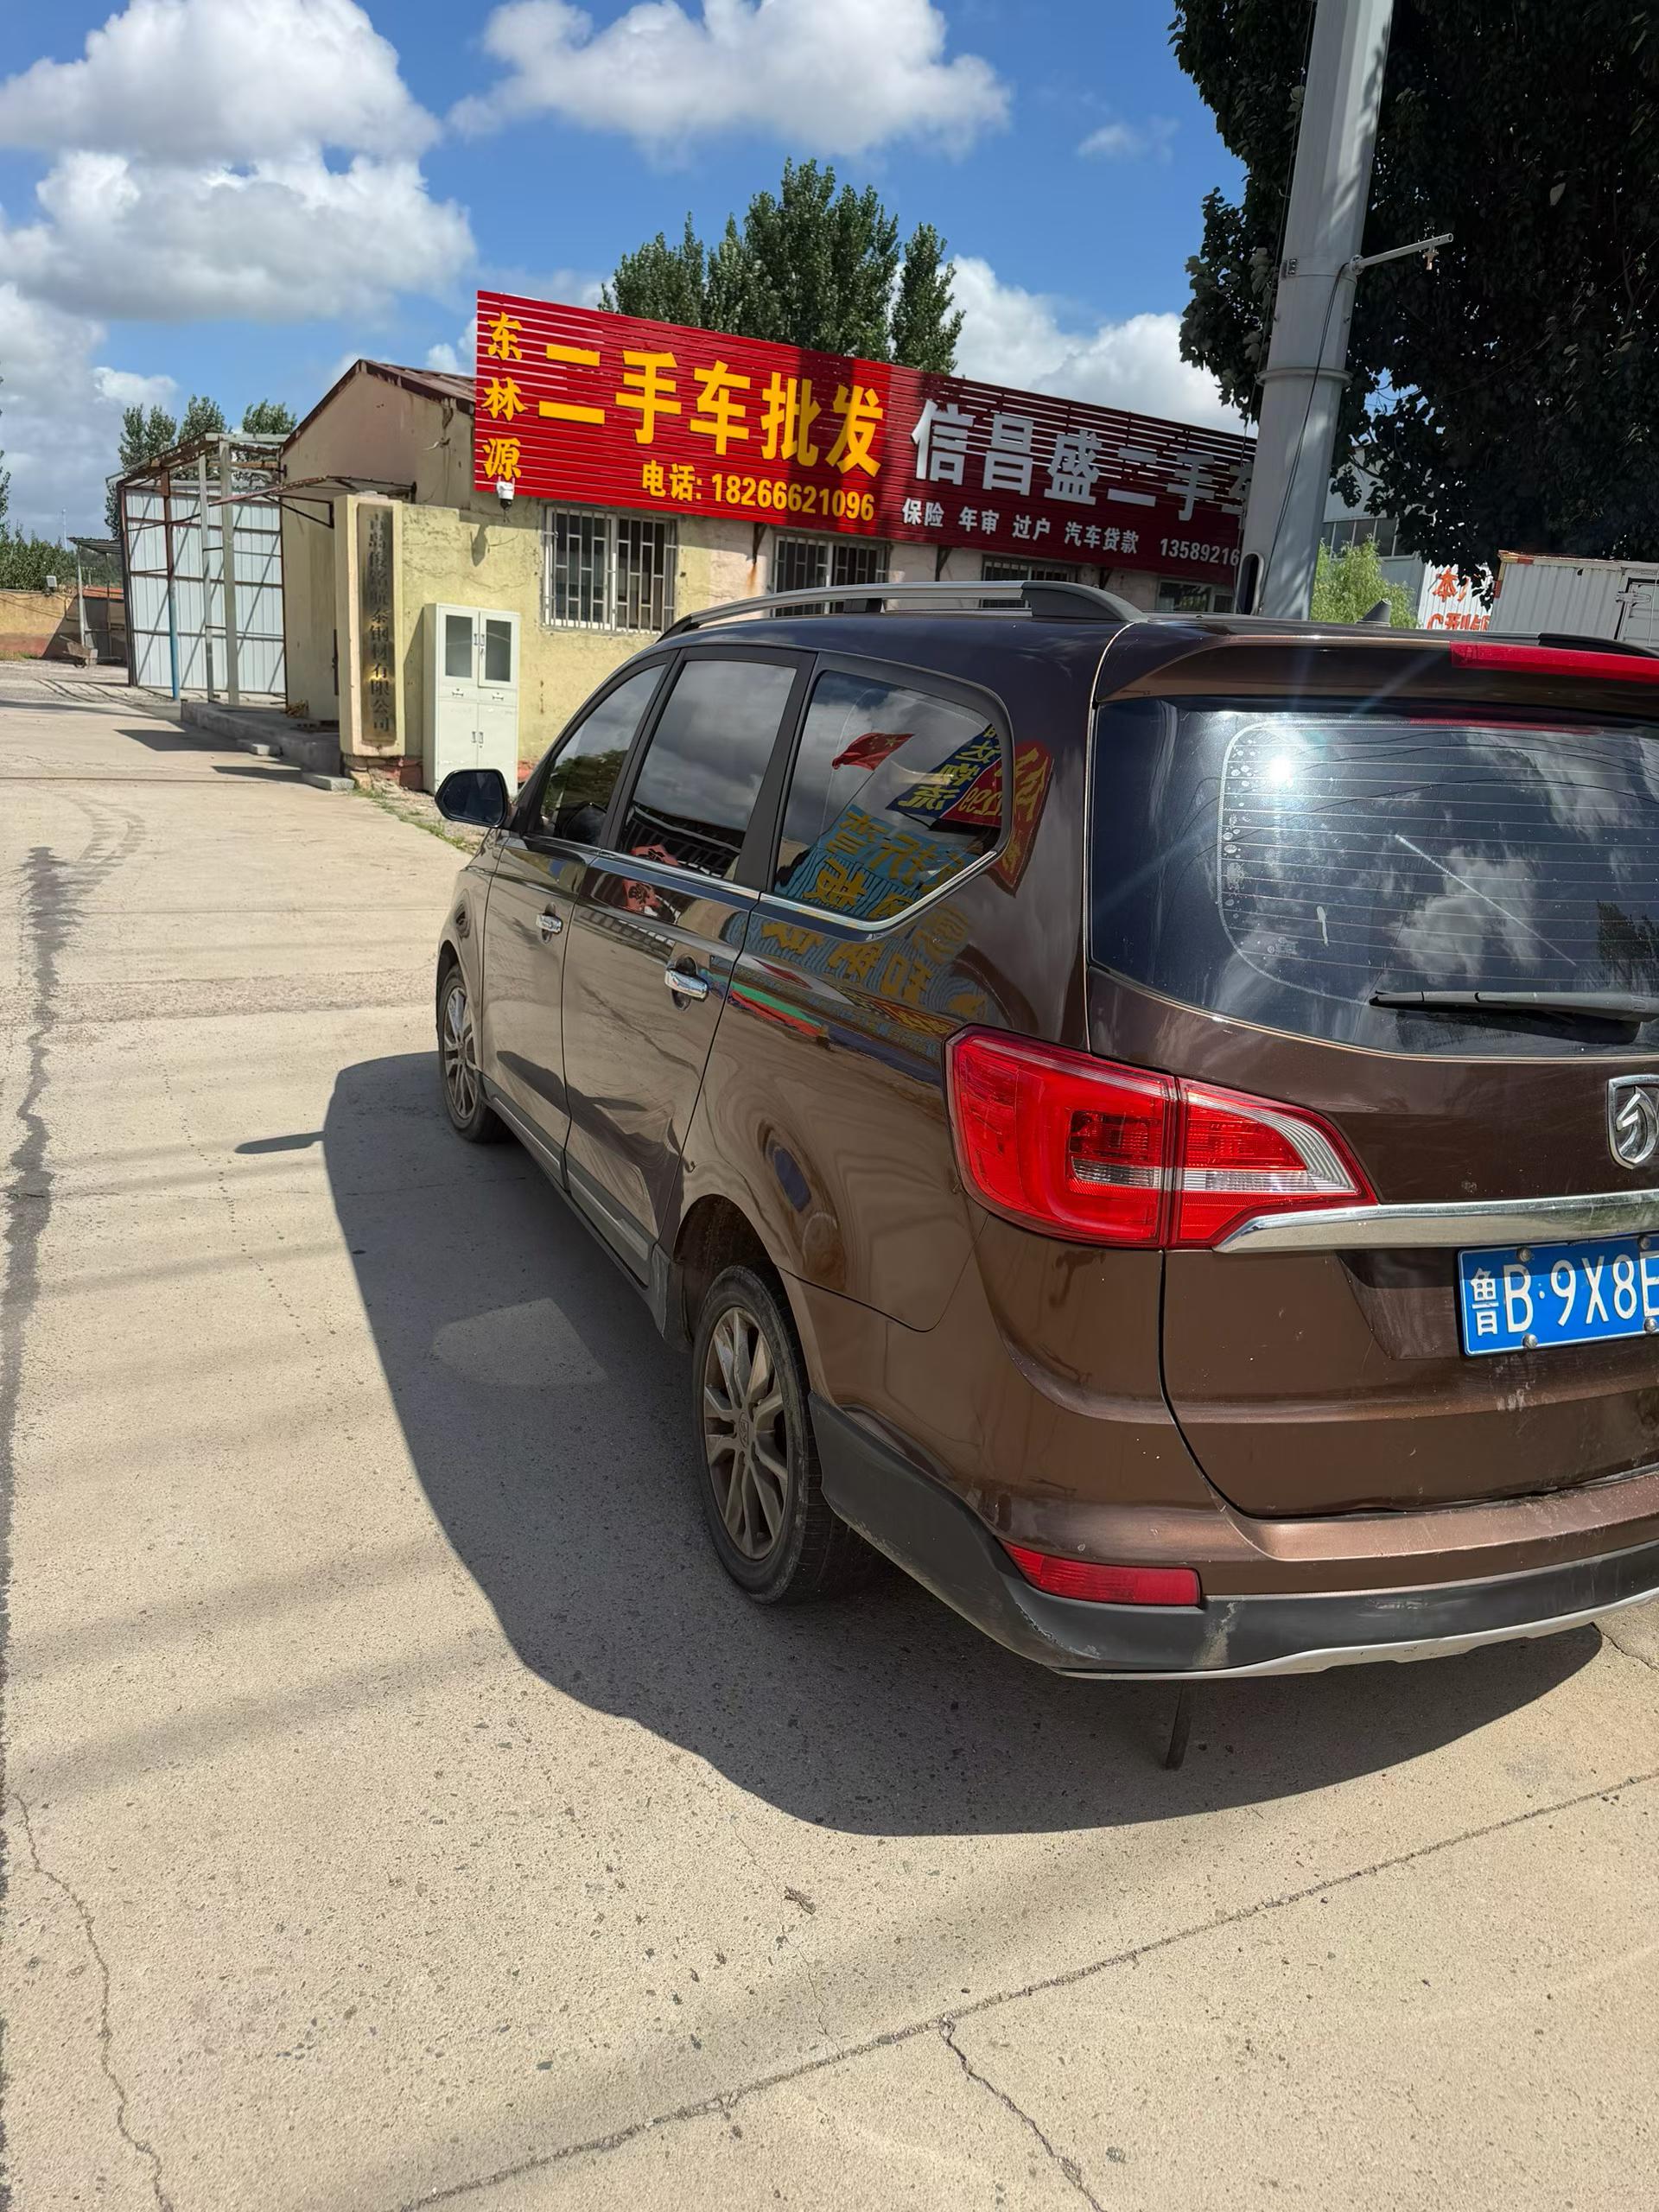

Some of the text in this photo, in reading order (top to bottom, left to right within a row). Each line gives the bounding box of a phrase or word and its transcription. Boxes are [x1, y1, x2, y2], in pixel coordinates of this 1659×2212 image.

[481, 311, 529, 481] 东林源
[538, 343, 884, 478] 二手车批发
[901, 497, 944, 529] 保险
[958, 505, 1000, 536] 年审
[1011, 513, 1052, 542] 过户
[1064, 520, 1140, 555] 汽车贷款
